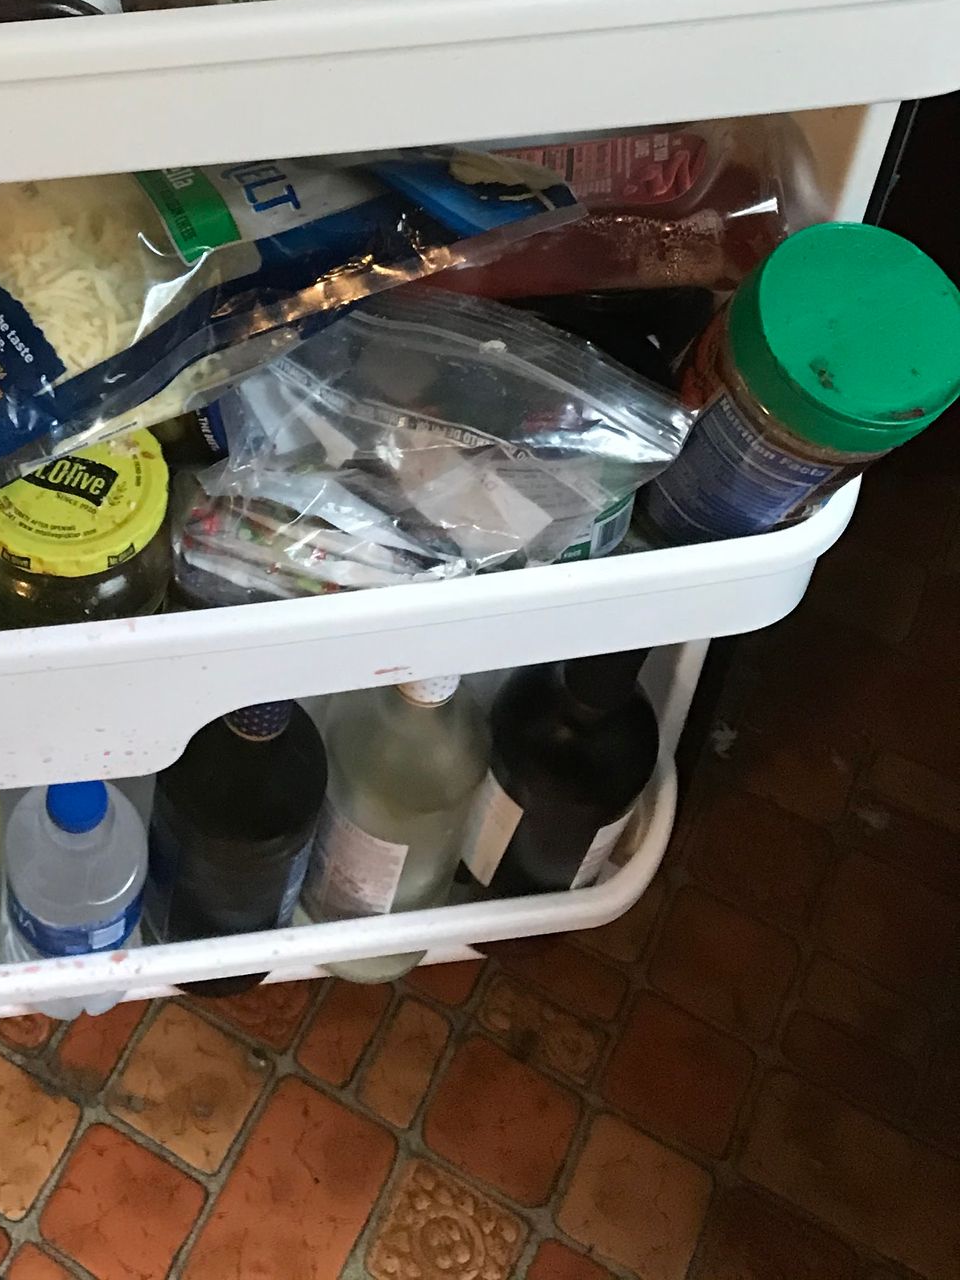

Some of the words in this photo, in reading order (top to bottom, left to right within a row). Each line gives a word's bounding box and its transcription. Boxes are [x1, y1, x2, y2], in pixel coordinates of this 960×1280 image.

[7, 330, 33, 363] taste
[200, 417, 211, 434] THE
[720, 398, 775, 459] Nutrition
[780, 458, 826, 476] Facts
[56, 492, 79, 506] SINCE
